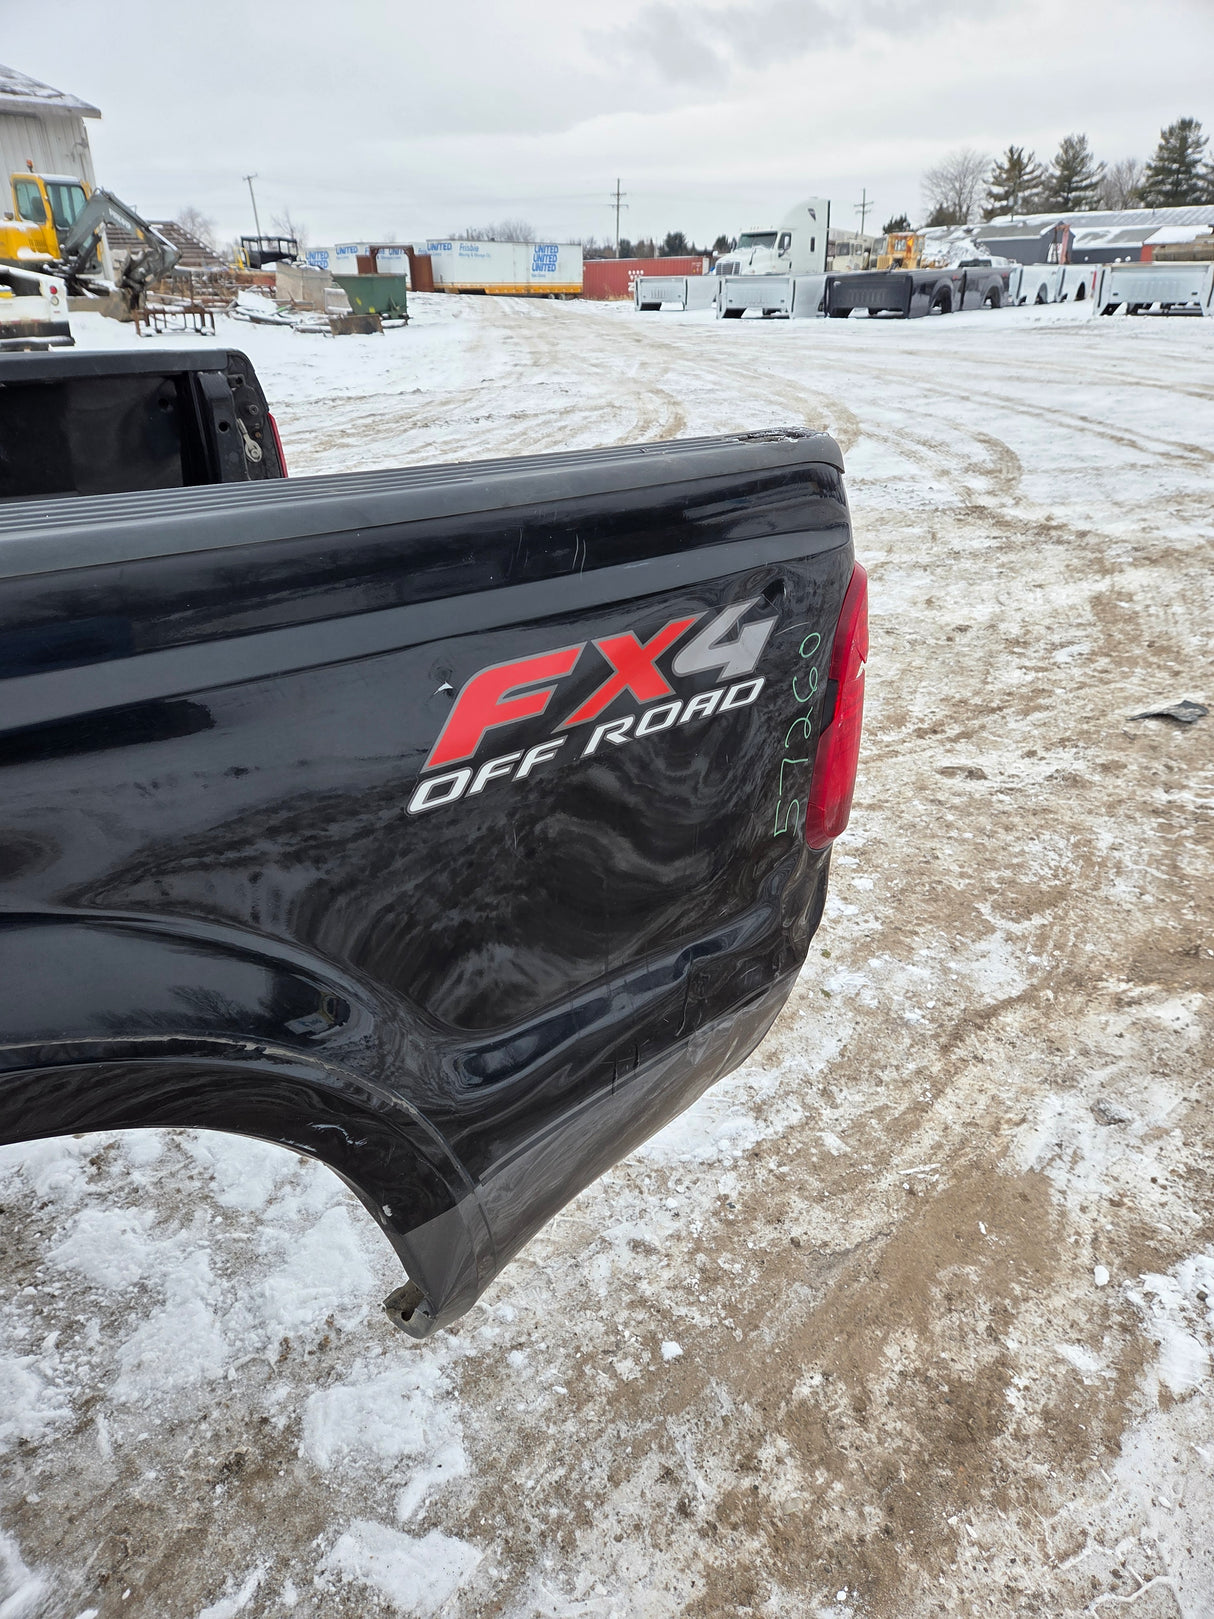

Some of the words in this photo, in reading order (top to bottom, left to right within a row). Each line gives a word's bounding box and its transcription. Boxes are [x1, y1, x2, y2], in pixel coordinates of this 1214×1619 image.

[335, 246, 359, 255] UNITED
[427, 242, 452, 251] UNITED
[534, 244, 559, 253] UNITED
[305, 251, 329, 260] UNITED
[533, 253, 558, 262] UNITED
[532, 262, 557, 272] UNITED
[420, 595, 779, 773] FX4
[774, 632, 821, 837] 57260
[406, 735, 568, 816] OFF
[581, 676, 766, 758] ROAD
